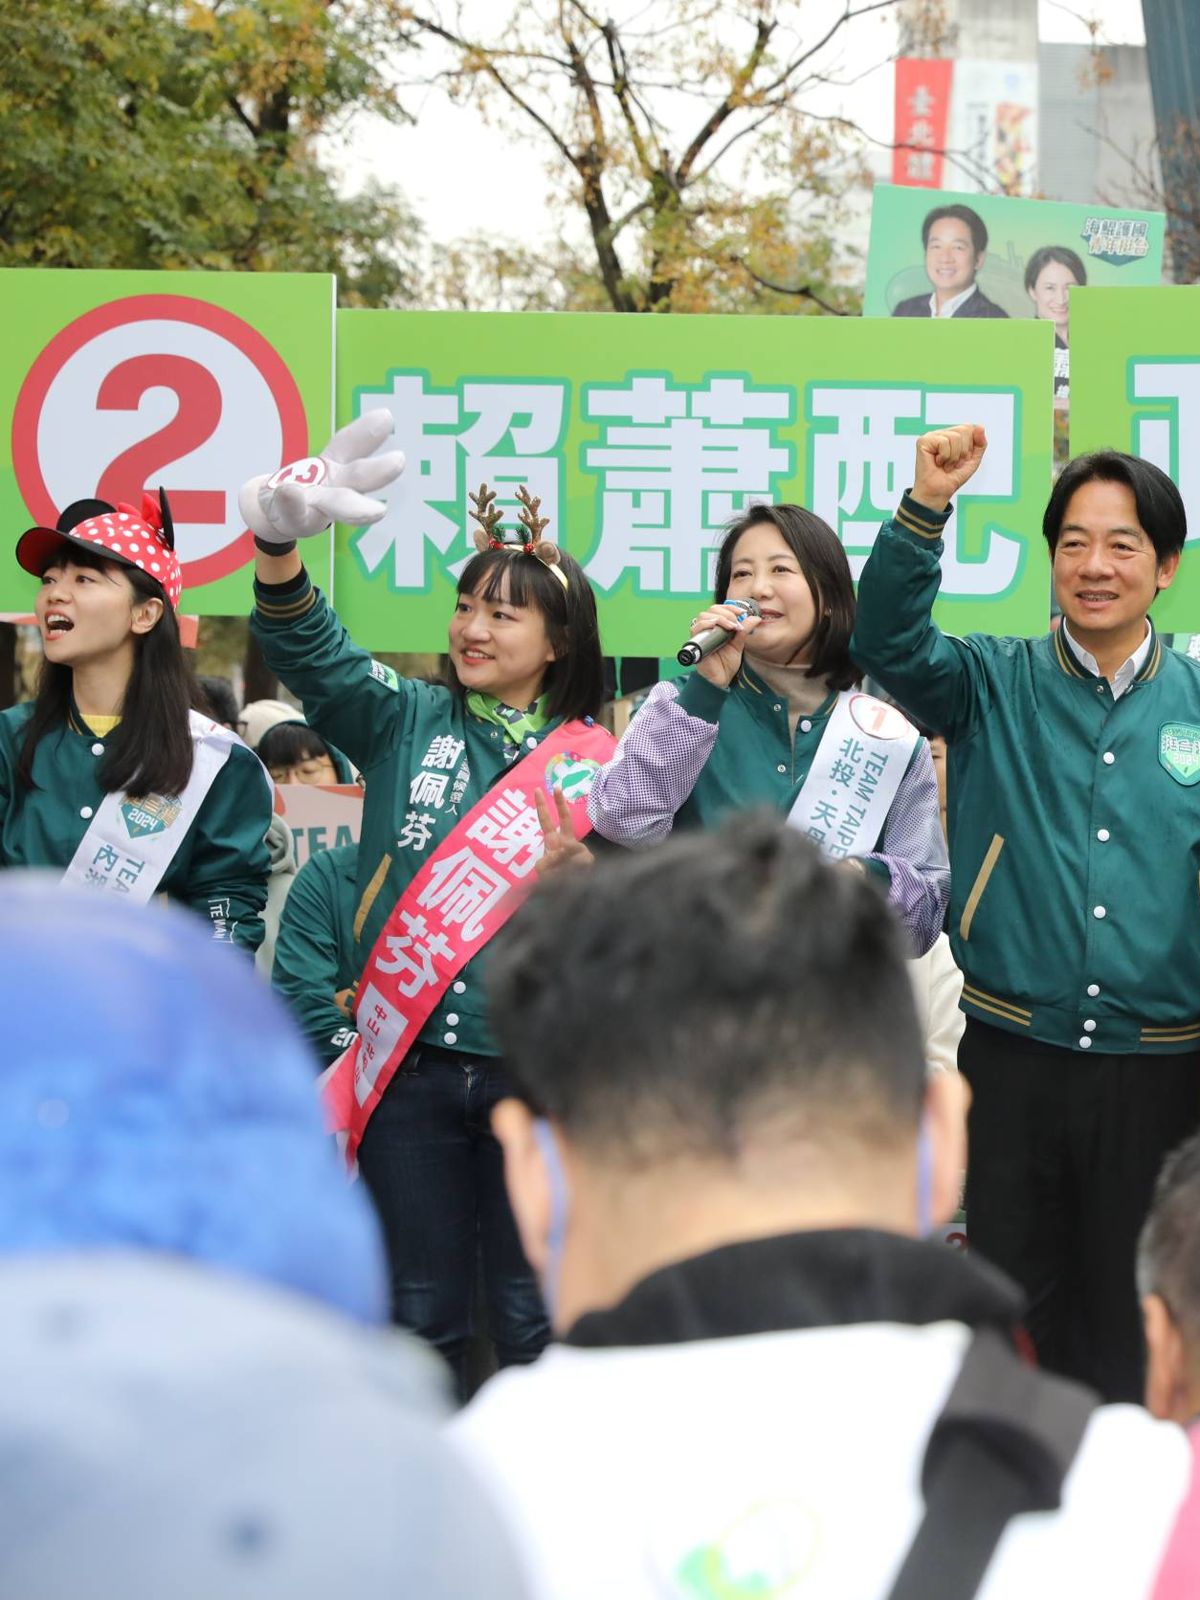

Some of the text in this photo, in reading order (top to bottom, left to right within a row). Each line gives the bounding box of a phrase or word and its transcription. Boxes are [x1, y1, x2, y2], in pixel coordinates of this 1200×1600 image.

[95, 353, 227, 525] 2
[128, 807, 159, 831] 2024
[397, 735, 466, 851] 謝佩芬
[855, 751, 890, 802] TEAM
[375, 787, 546, 999] 謝佩芬
